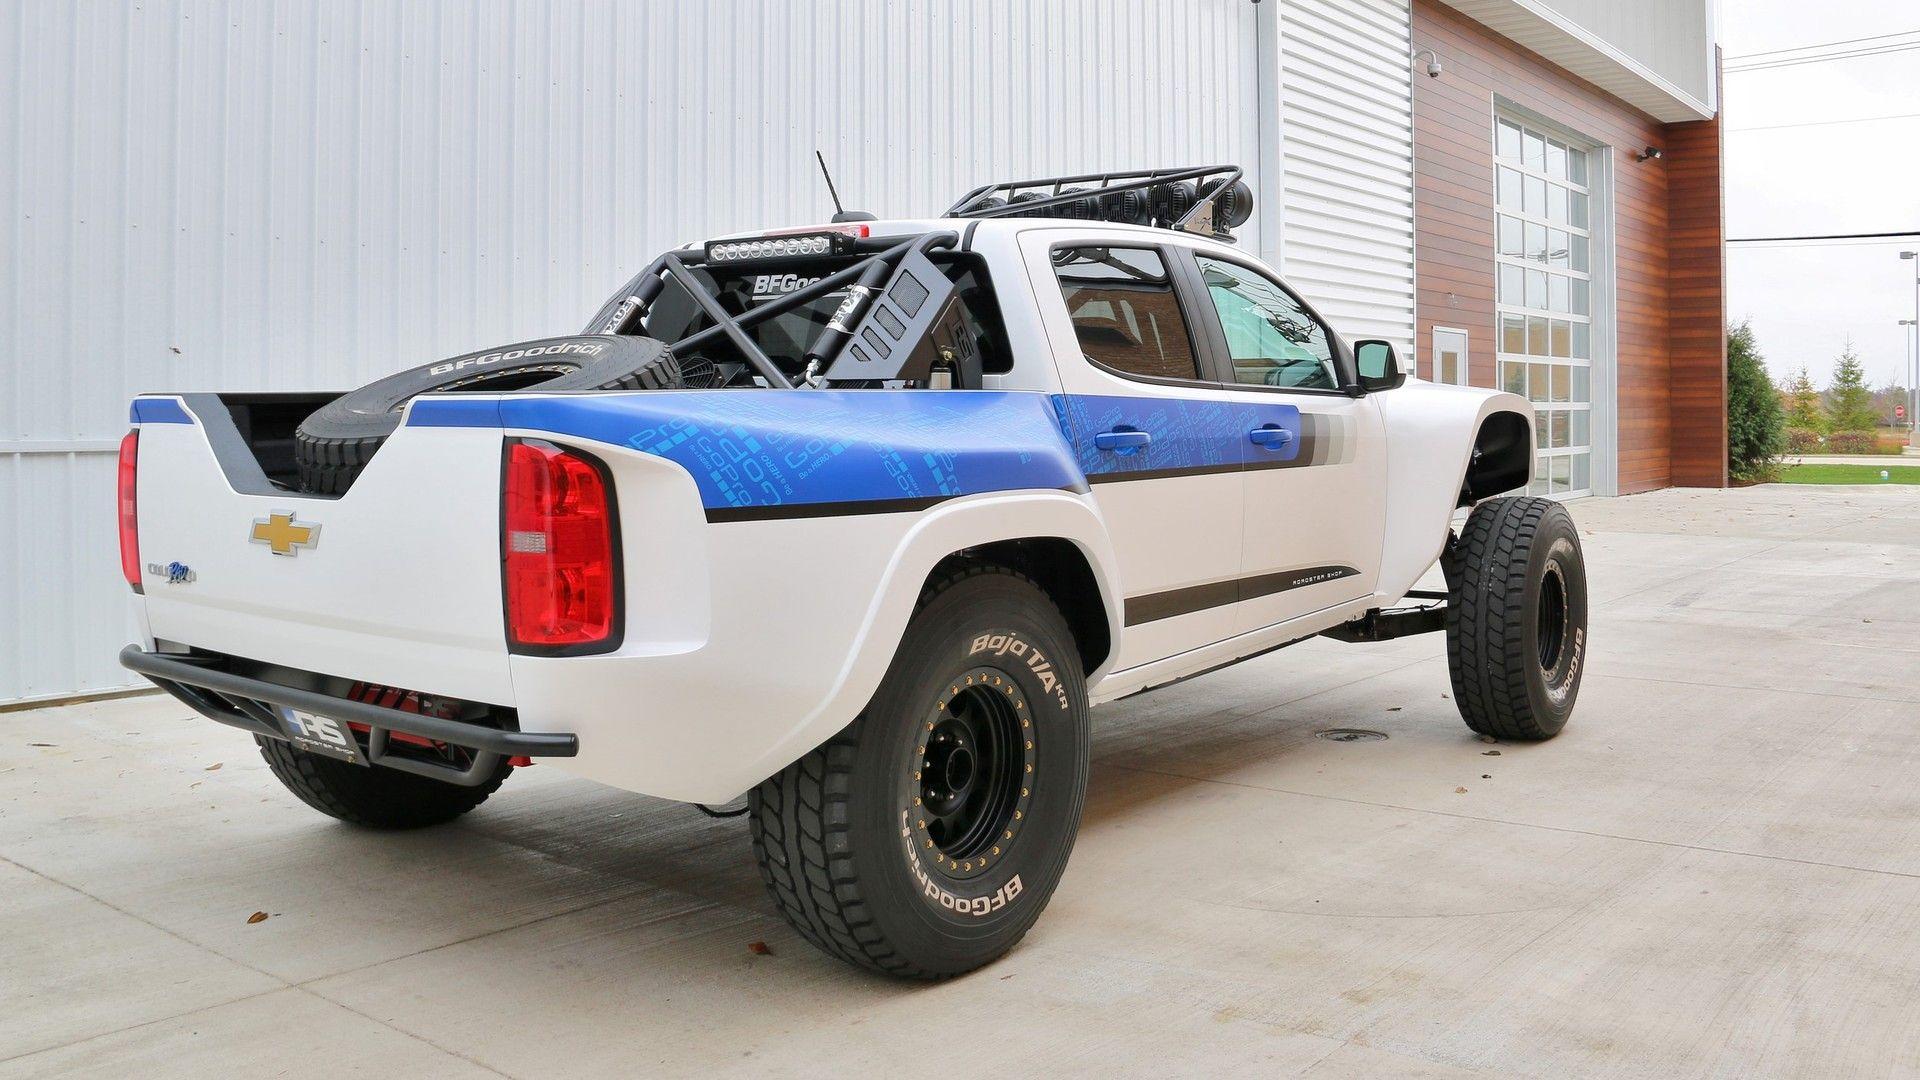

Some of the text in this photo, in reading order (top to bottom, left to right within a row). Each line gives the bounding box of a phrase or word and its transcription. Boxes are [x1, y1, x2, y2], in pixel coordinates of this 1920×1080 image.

[430, 342, 603, 376] BFGoodrich
[1327, 570, 1343, 579] SHOP
[968, 632, 1029, 656] Baja
[291, 709, 347, 746] RS
[902, 808, 1023, 917] BFGoodrich
